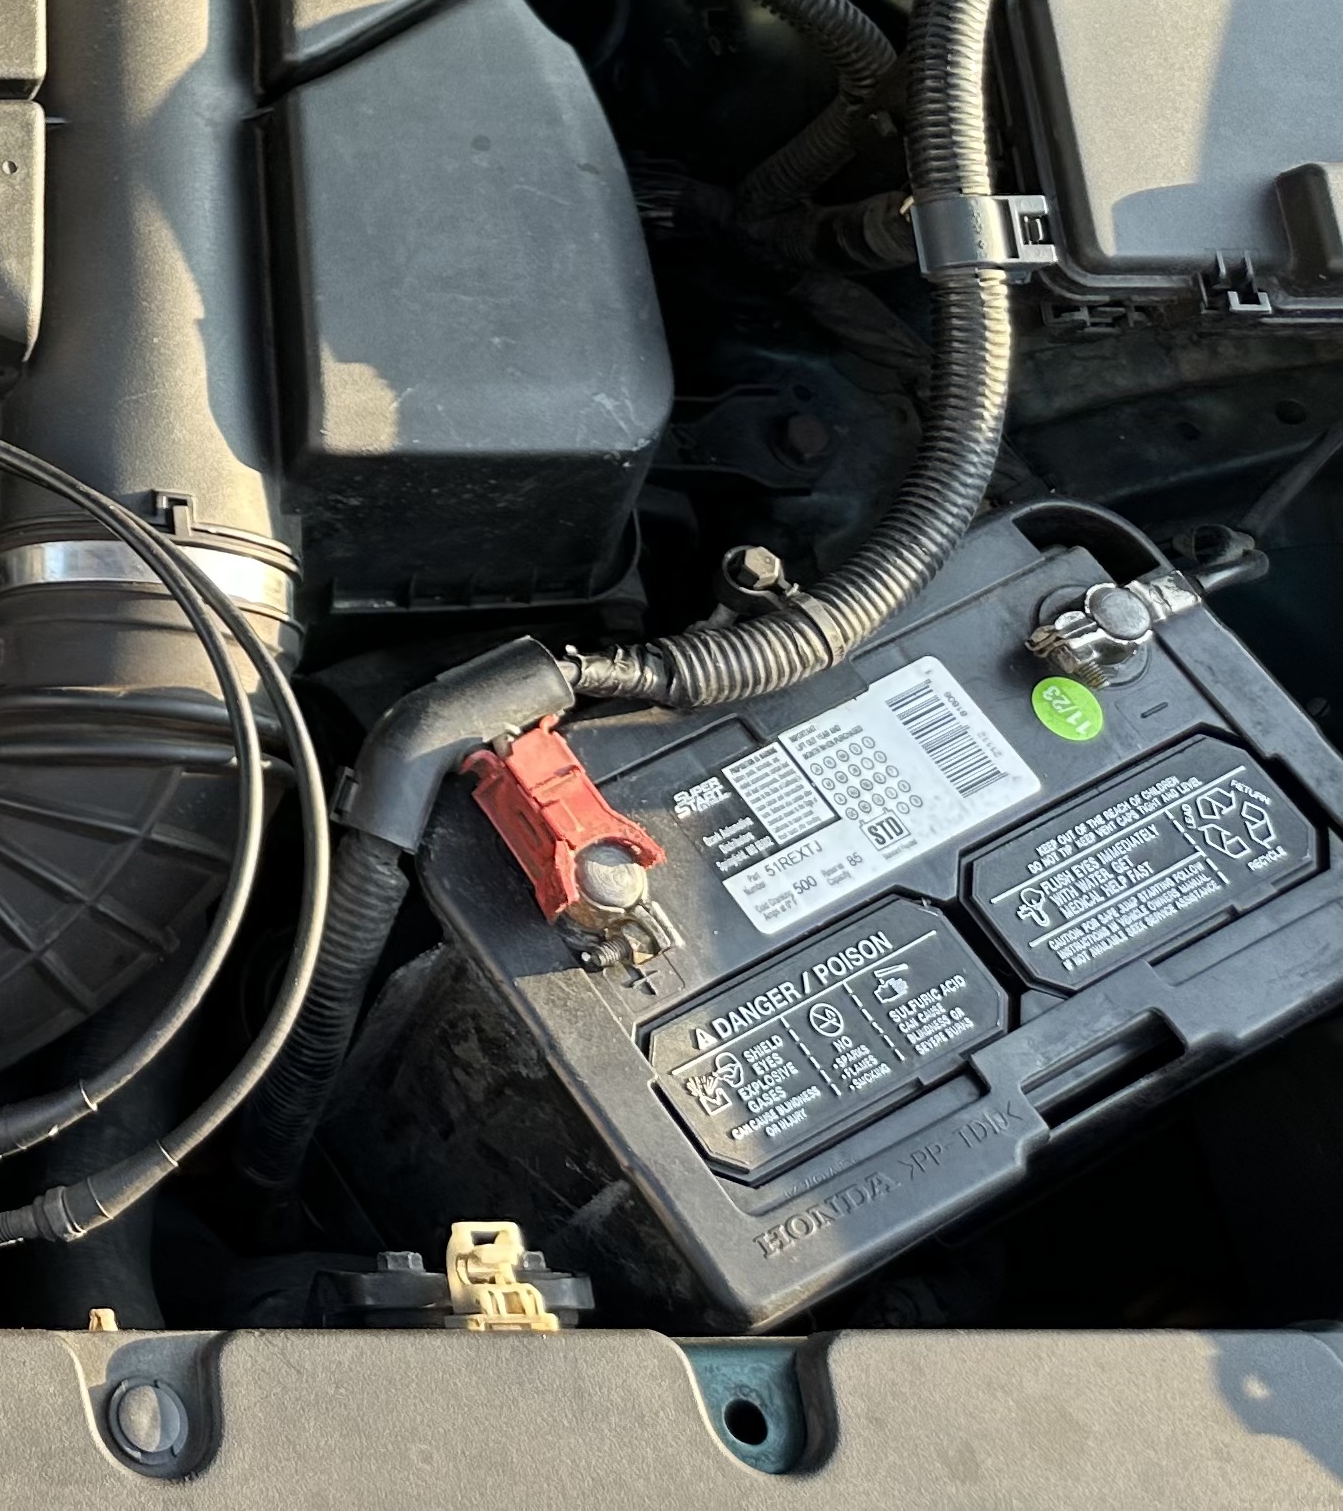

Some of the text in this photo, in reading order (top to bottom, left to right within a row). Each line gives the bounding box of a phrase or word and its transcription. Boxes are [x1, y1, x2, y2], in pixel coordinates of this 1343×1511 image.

[1039, 683, 1102, 739] 11/23
[673, 776, 723, 806] SUPER
[674, 791, 732, 819] START
[1230, 779, 1273, 805] RETURN
[868, 816, 905, 851] STD
[1028, 775, 1202, 874] DO NOT TIP KEEP VENT CAPS TIGHT AND LEVEL
[1036, 774, 1178, 856] KEEP OUT OF THE REACH OF CHILDREN
[763, 839, 823, 877] 51REXTJ
[792, 852, 863, 894] 500 85
[1040, 823, 1159, 895] FLUSH EYES IMMEDIATELY
[1246, 846, 1288, 872] RECYCLE
[1049, 885, 1078, 907] WITH
[1111, 855, 1133, 874] GET
[1060, 861, 1154, 919] MEDICAL HELP FAST
[1081, 917, 1100, 933] FOR
[1098, 906, 1119, 924] SAFE
[1117, 896, 1138, 914] JUMP
[1137, 876, 1175, 903] STARTING
[1172, 861, 1204, 883] FOLLOW
[1057, 925, 1110, 960] INSTRUCTIONS
[1108, 920, 1120, 932] IN
[1118, 904, 1148, 927] VEHICLE
[1147, 887, 1180, 911] OWNERS
[1071, 950, 1090, 966] NOT
[1088, 930, 1127, 957] AVAILABLE
[1125, 919, 1147, 937] SEEK
[1144, 903, 1177, 927] SERVICE
[712, 981, 802, 1039] DANGER
[816, 931, 895, 986] POISON
[888, 974, 967, 1024] SULFURIC ACID
[898, 1002, 945, 1033] CAN CAUSE
[906, 1006, 965, 1044] BLINDNESS OR
[915, 1016, 973, 1055] SEVERE BURNS
[742, 1034, 784, 1063] SHIELD
[751, 1051, 783, 1076] EYES
[833, 1035, 853, 1053] NO
[737, 1061, 798, 1101] EXPLOSIVE
[747, 1085, 787, 1114] GASES
[731, 1085, 821, 1140] CAN CAUSE BLINDNESS
[765, 1108, 808, 1137] OR INJURY
[752, 1171, 903, 1260] HONDA
